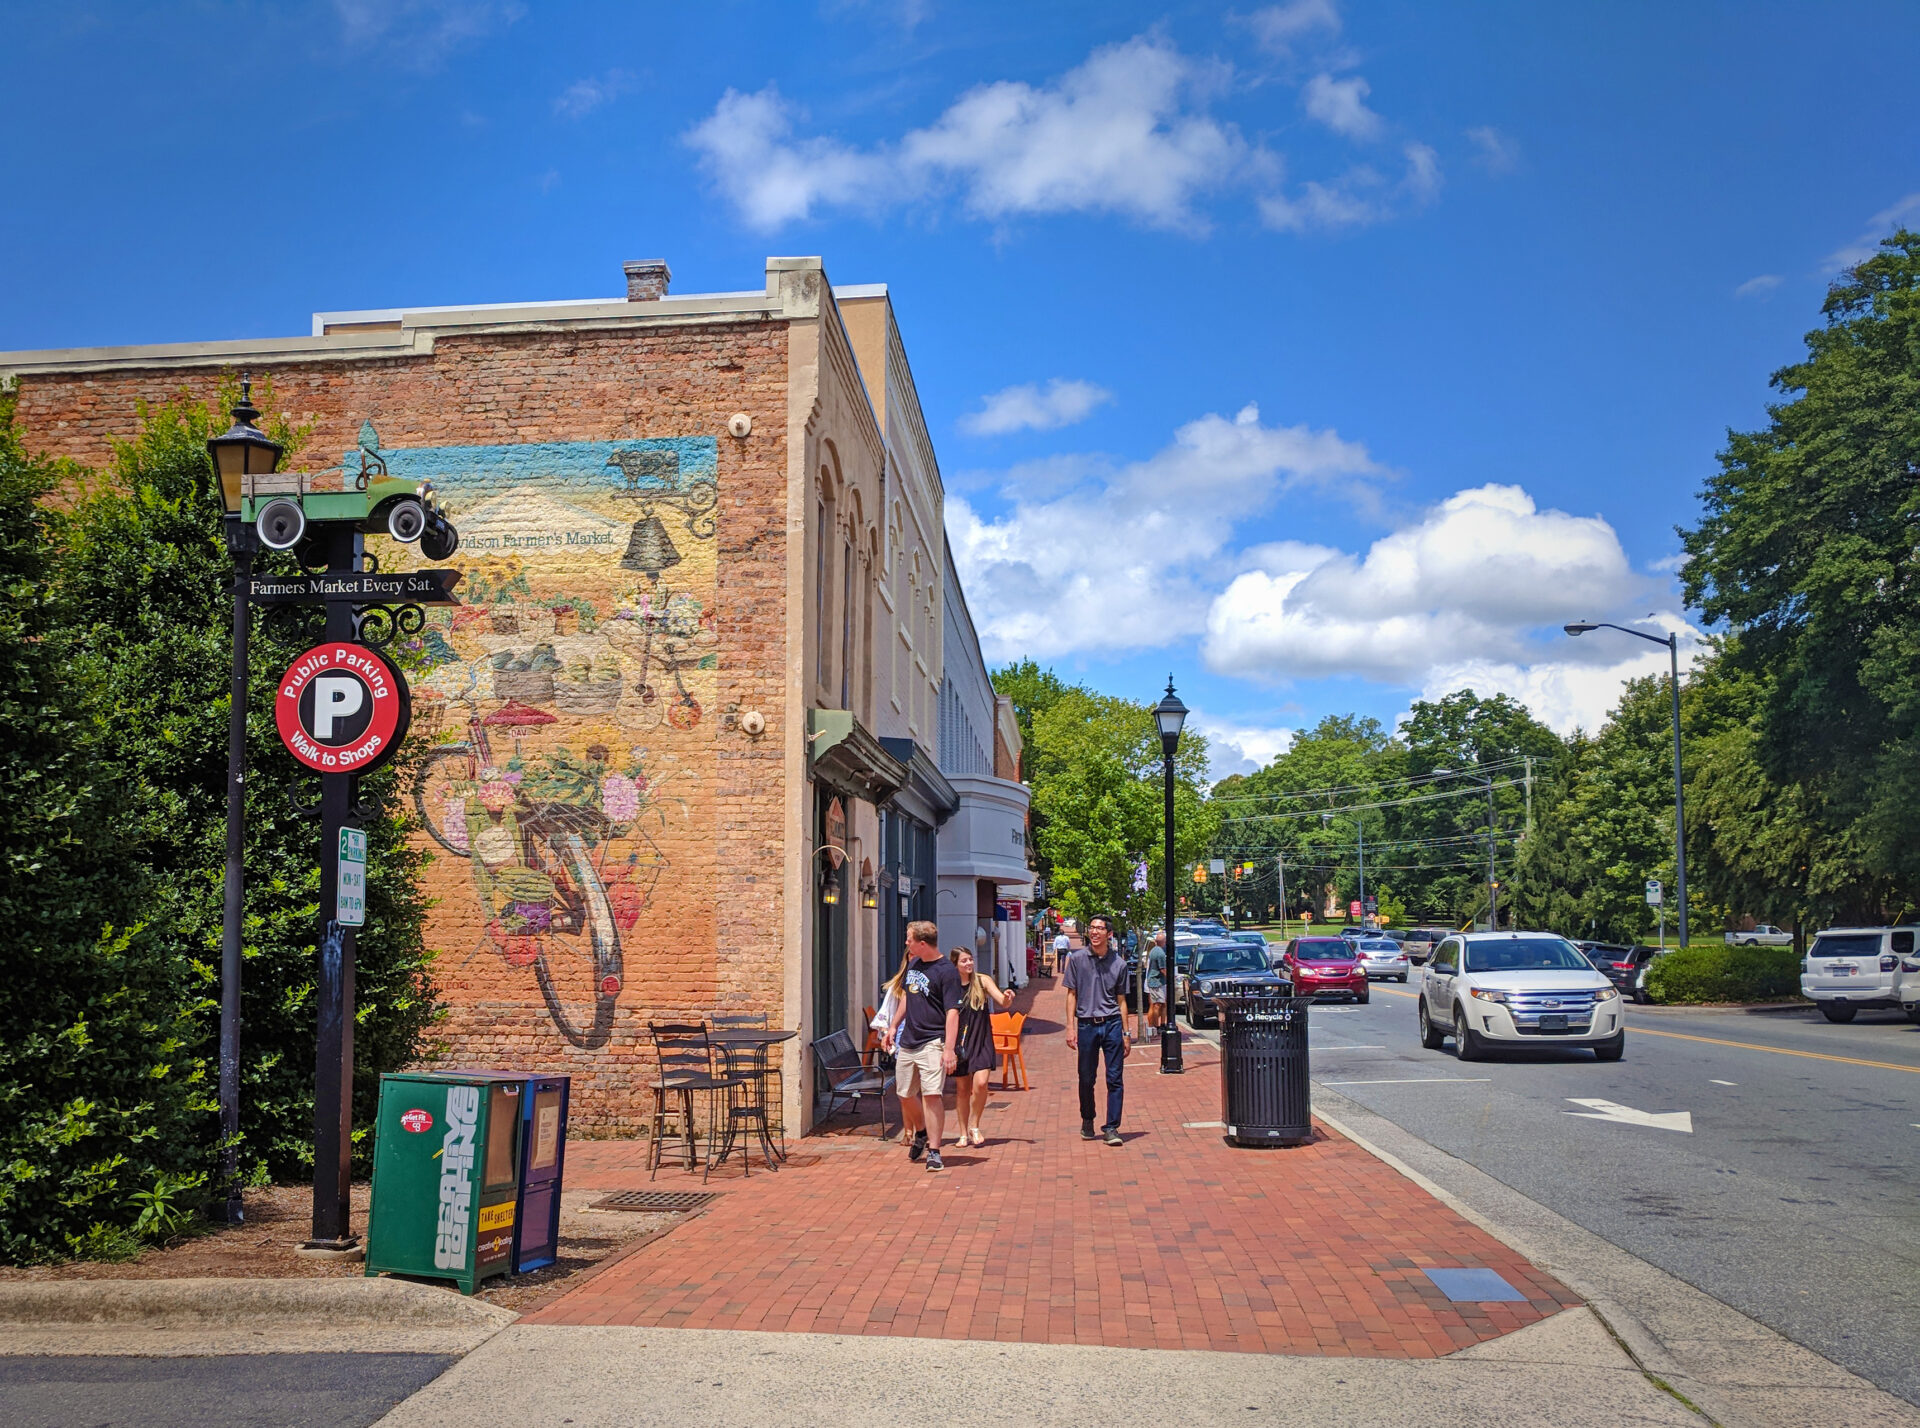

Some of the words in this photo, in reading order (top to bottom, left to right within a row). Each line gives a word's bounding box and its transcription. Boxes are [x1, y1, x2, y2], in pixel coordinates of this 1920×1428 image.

[458, 537, 500, 549] vidson
[502, 533, 562, 548] Farmer's
[566, 531, 614, 545] Market
[250, 581, 305, 595] Farmers
[309, 579, 359, 593] Market
[362, 578, 403, 595] Every
[407, 577, 434, 591] Sat.
[283, 654, 329, 699] Public
[335, 649, 389, 699] Parking
[314, 677, 363, 738] P
[290, 730, 320, 762] Walk
[321, 751, 336, 766] to
[339, 735, 382, 765] Shops
[341, 836, 348, 854] 2
[1255, 1013, 1283, 1021] Recycle
[408, 1113, 418, 1121] Get
[481, 1210, 494, 1224] TAKE
